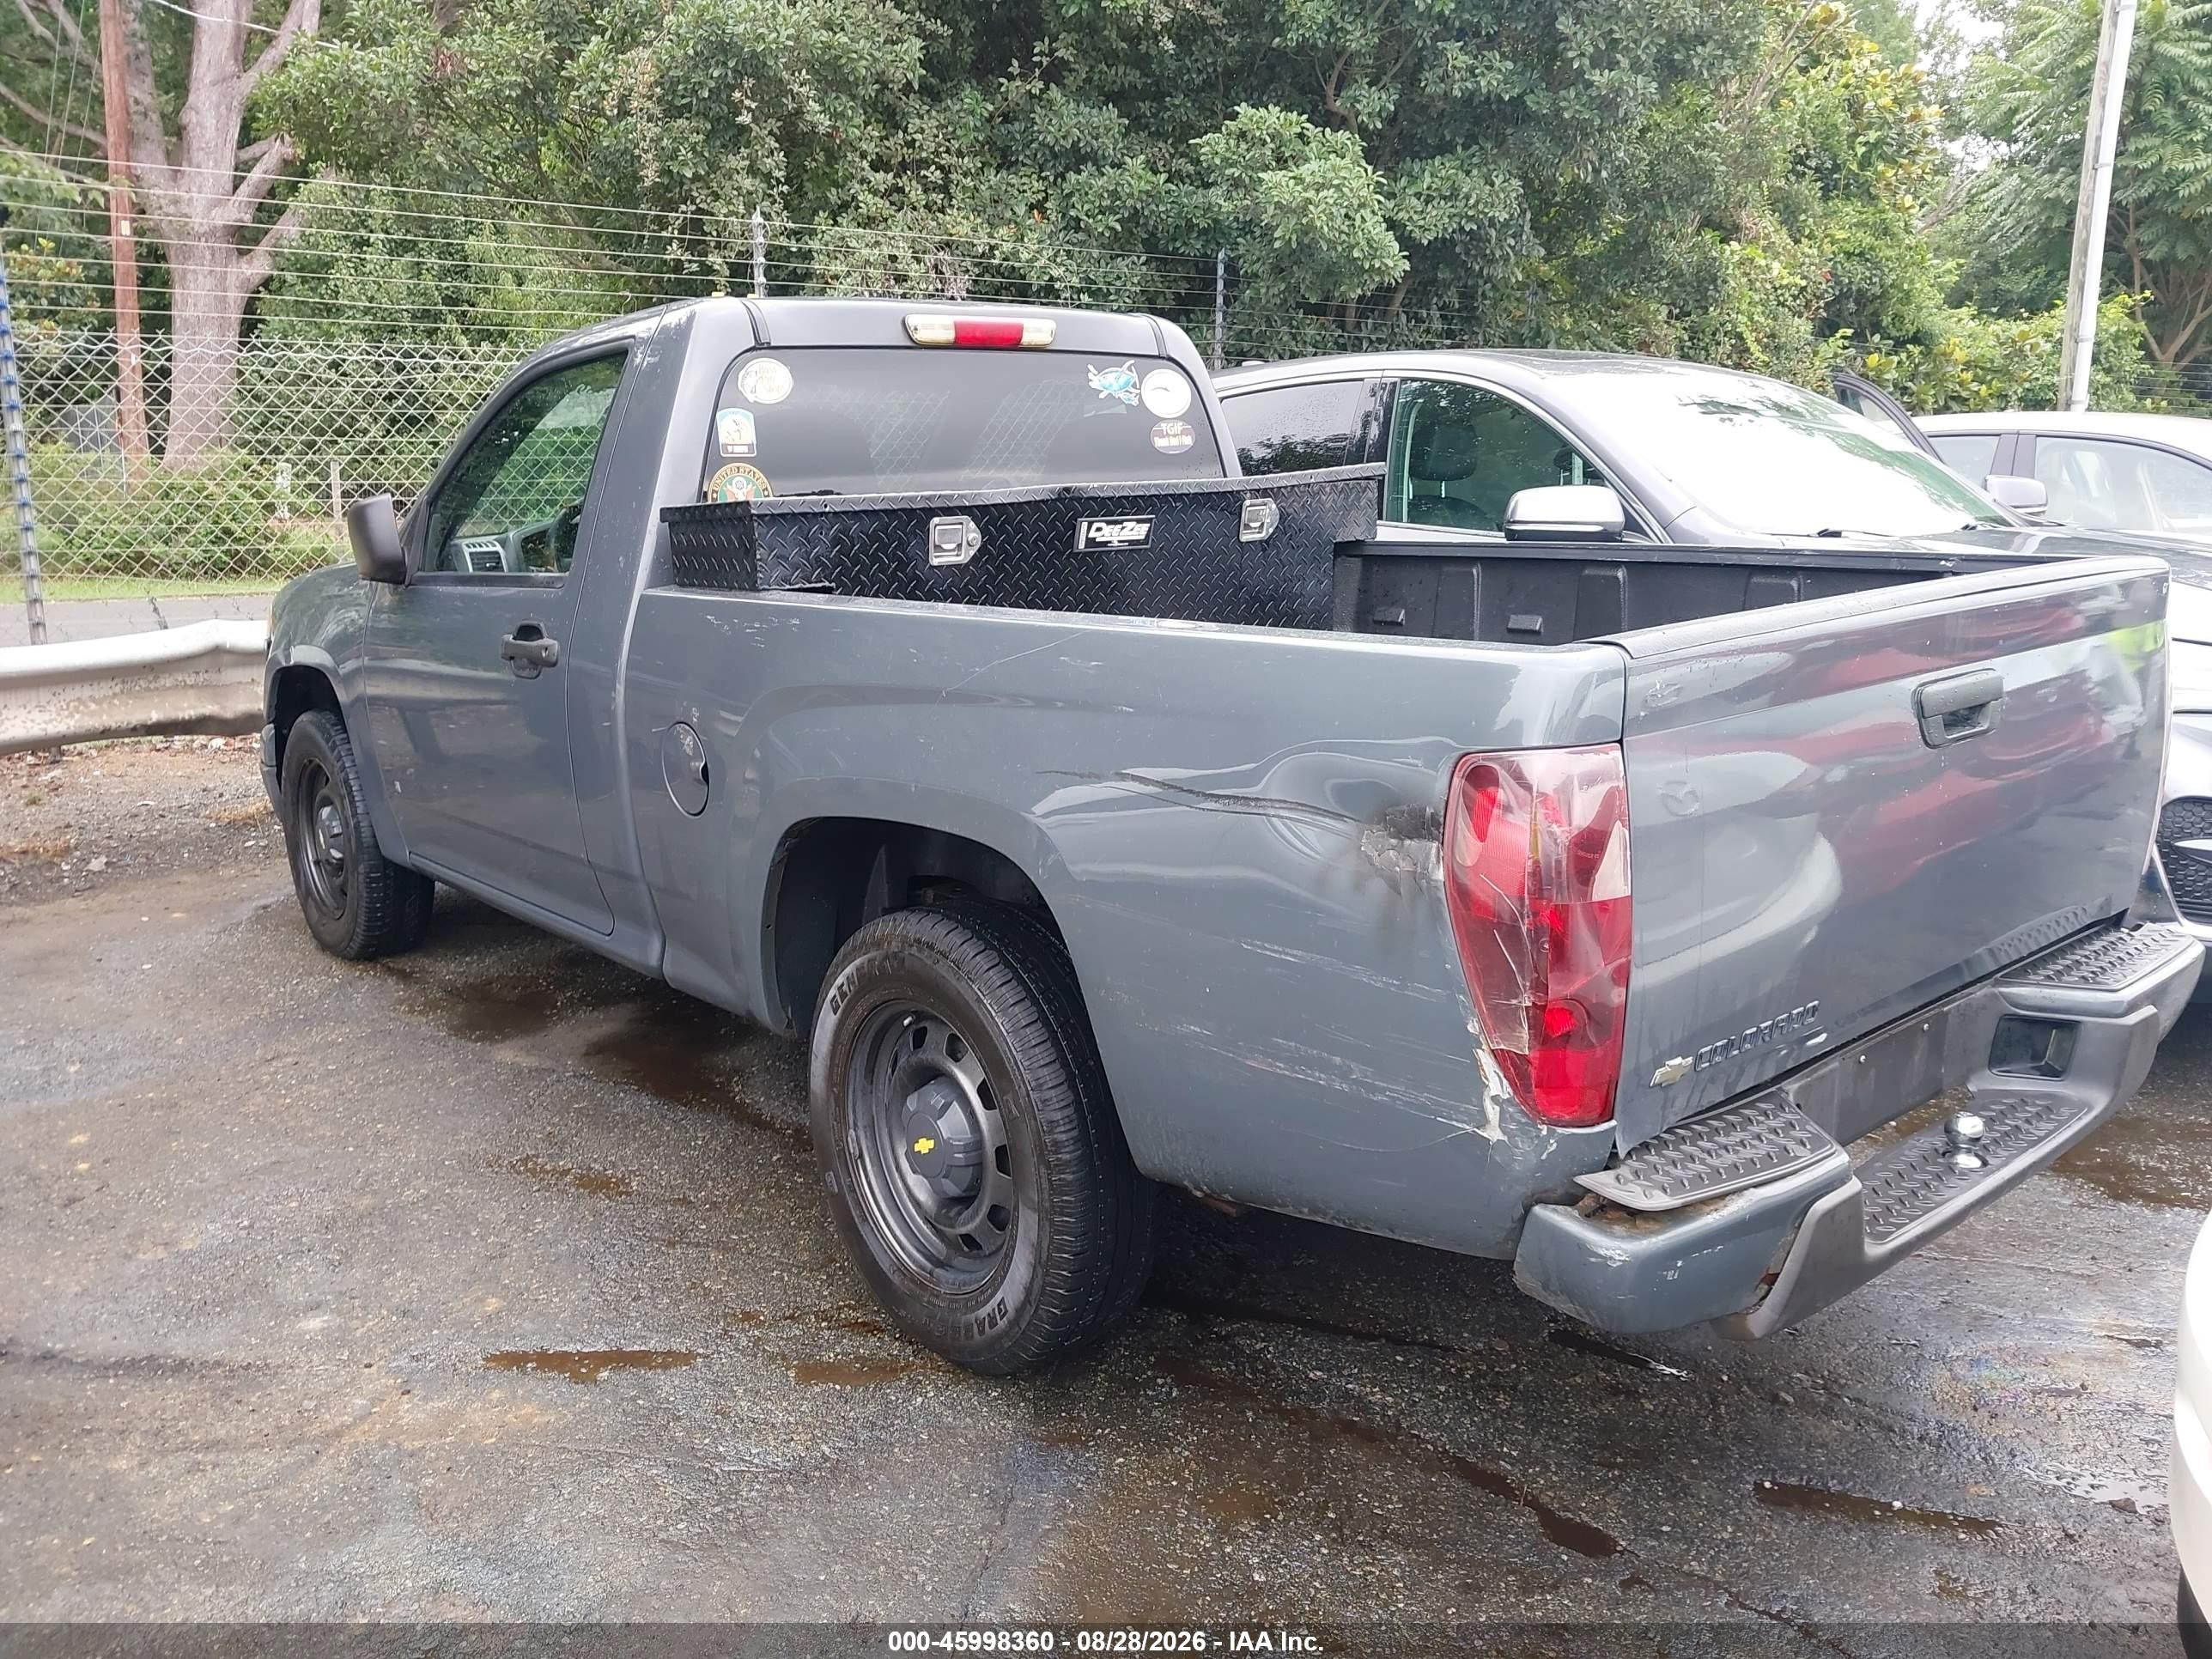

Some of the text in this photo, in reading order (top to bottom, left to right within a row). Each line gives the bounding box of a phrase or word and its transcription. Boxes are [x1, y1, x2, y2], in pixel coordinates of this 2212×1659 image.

[1160, 422, 1183, 435] TGIF
[714, 466, 767, 490] UNITED STATES
[1694, 1000, 1820, 1072] COLORADO
